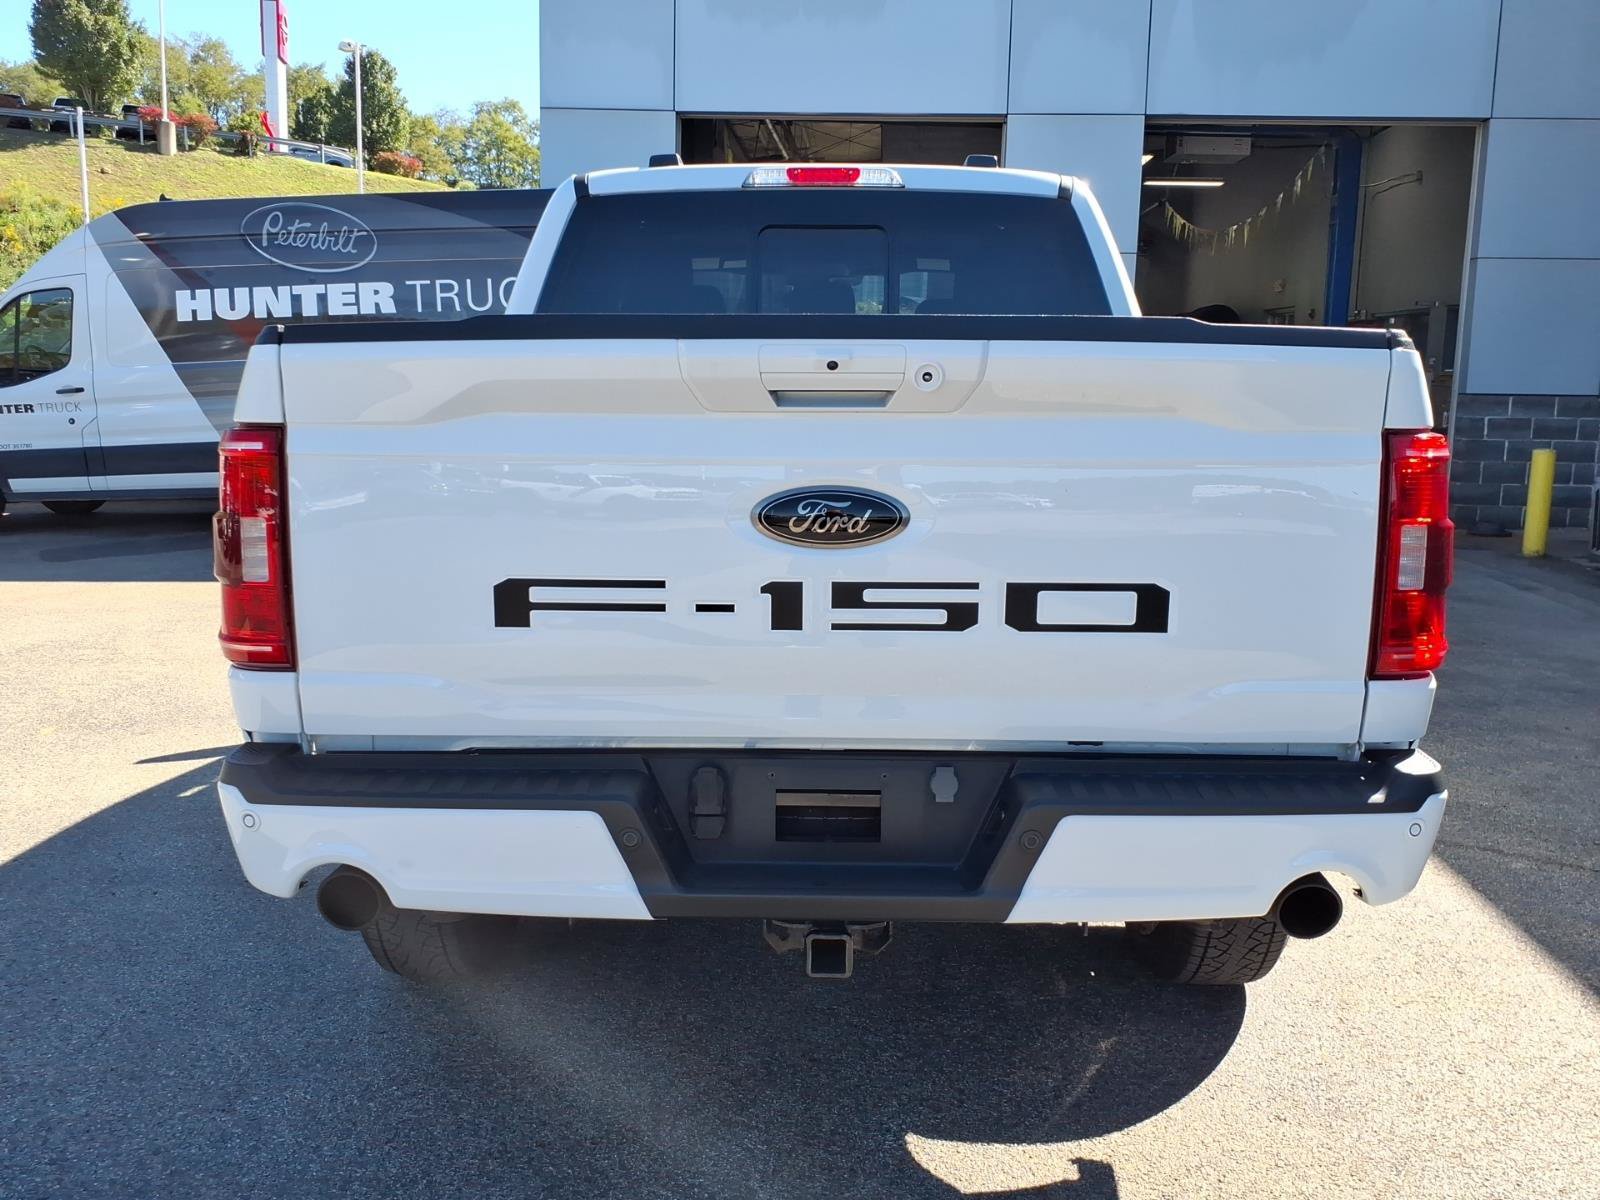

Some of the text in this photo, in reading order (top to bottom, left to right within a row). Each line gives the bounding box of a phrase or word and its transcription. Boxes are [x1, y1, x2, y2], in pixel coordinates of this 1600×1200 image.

[262, 211, 367, 253] Peterbilt
[176, 282, 397, 321] HUNTER
[38, 402, 82, 413] TRUCK
[788, 499, 873, 533] Ford
[493, 577, 1170, 633] F-150
